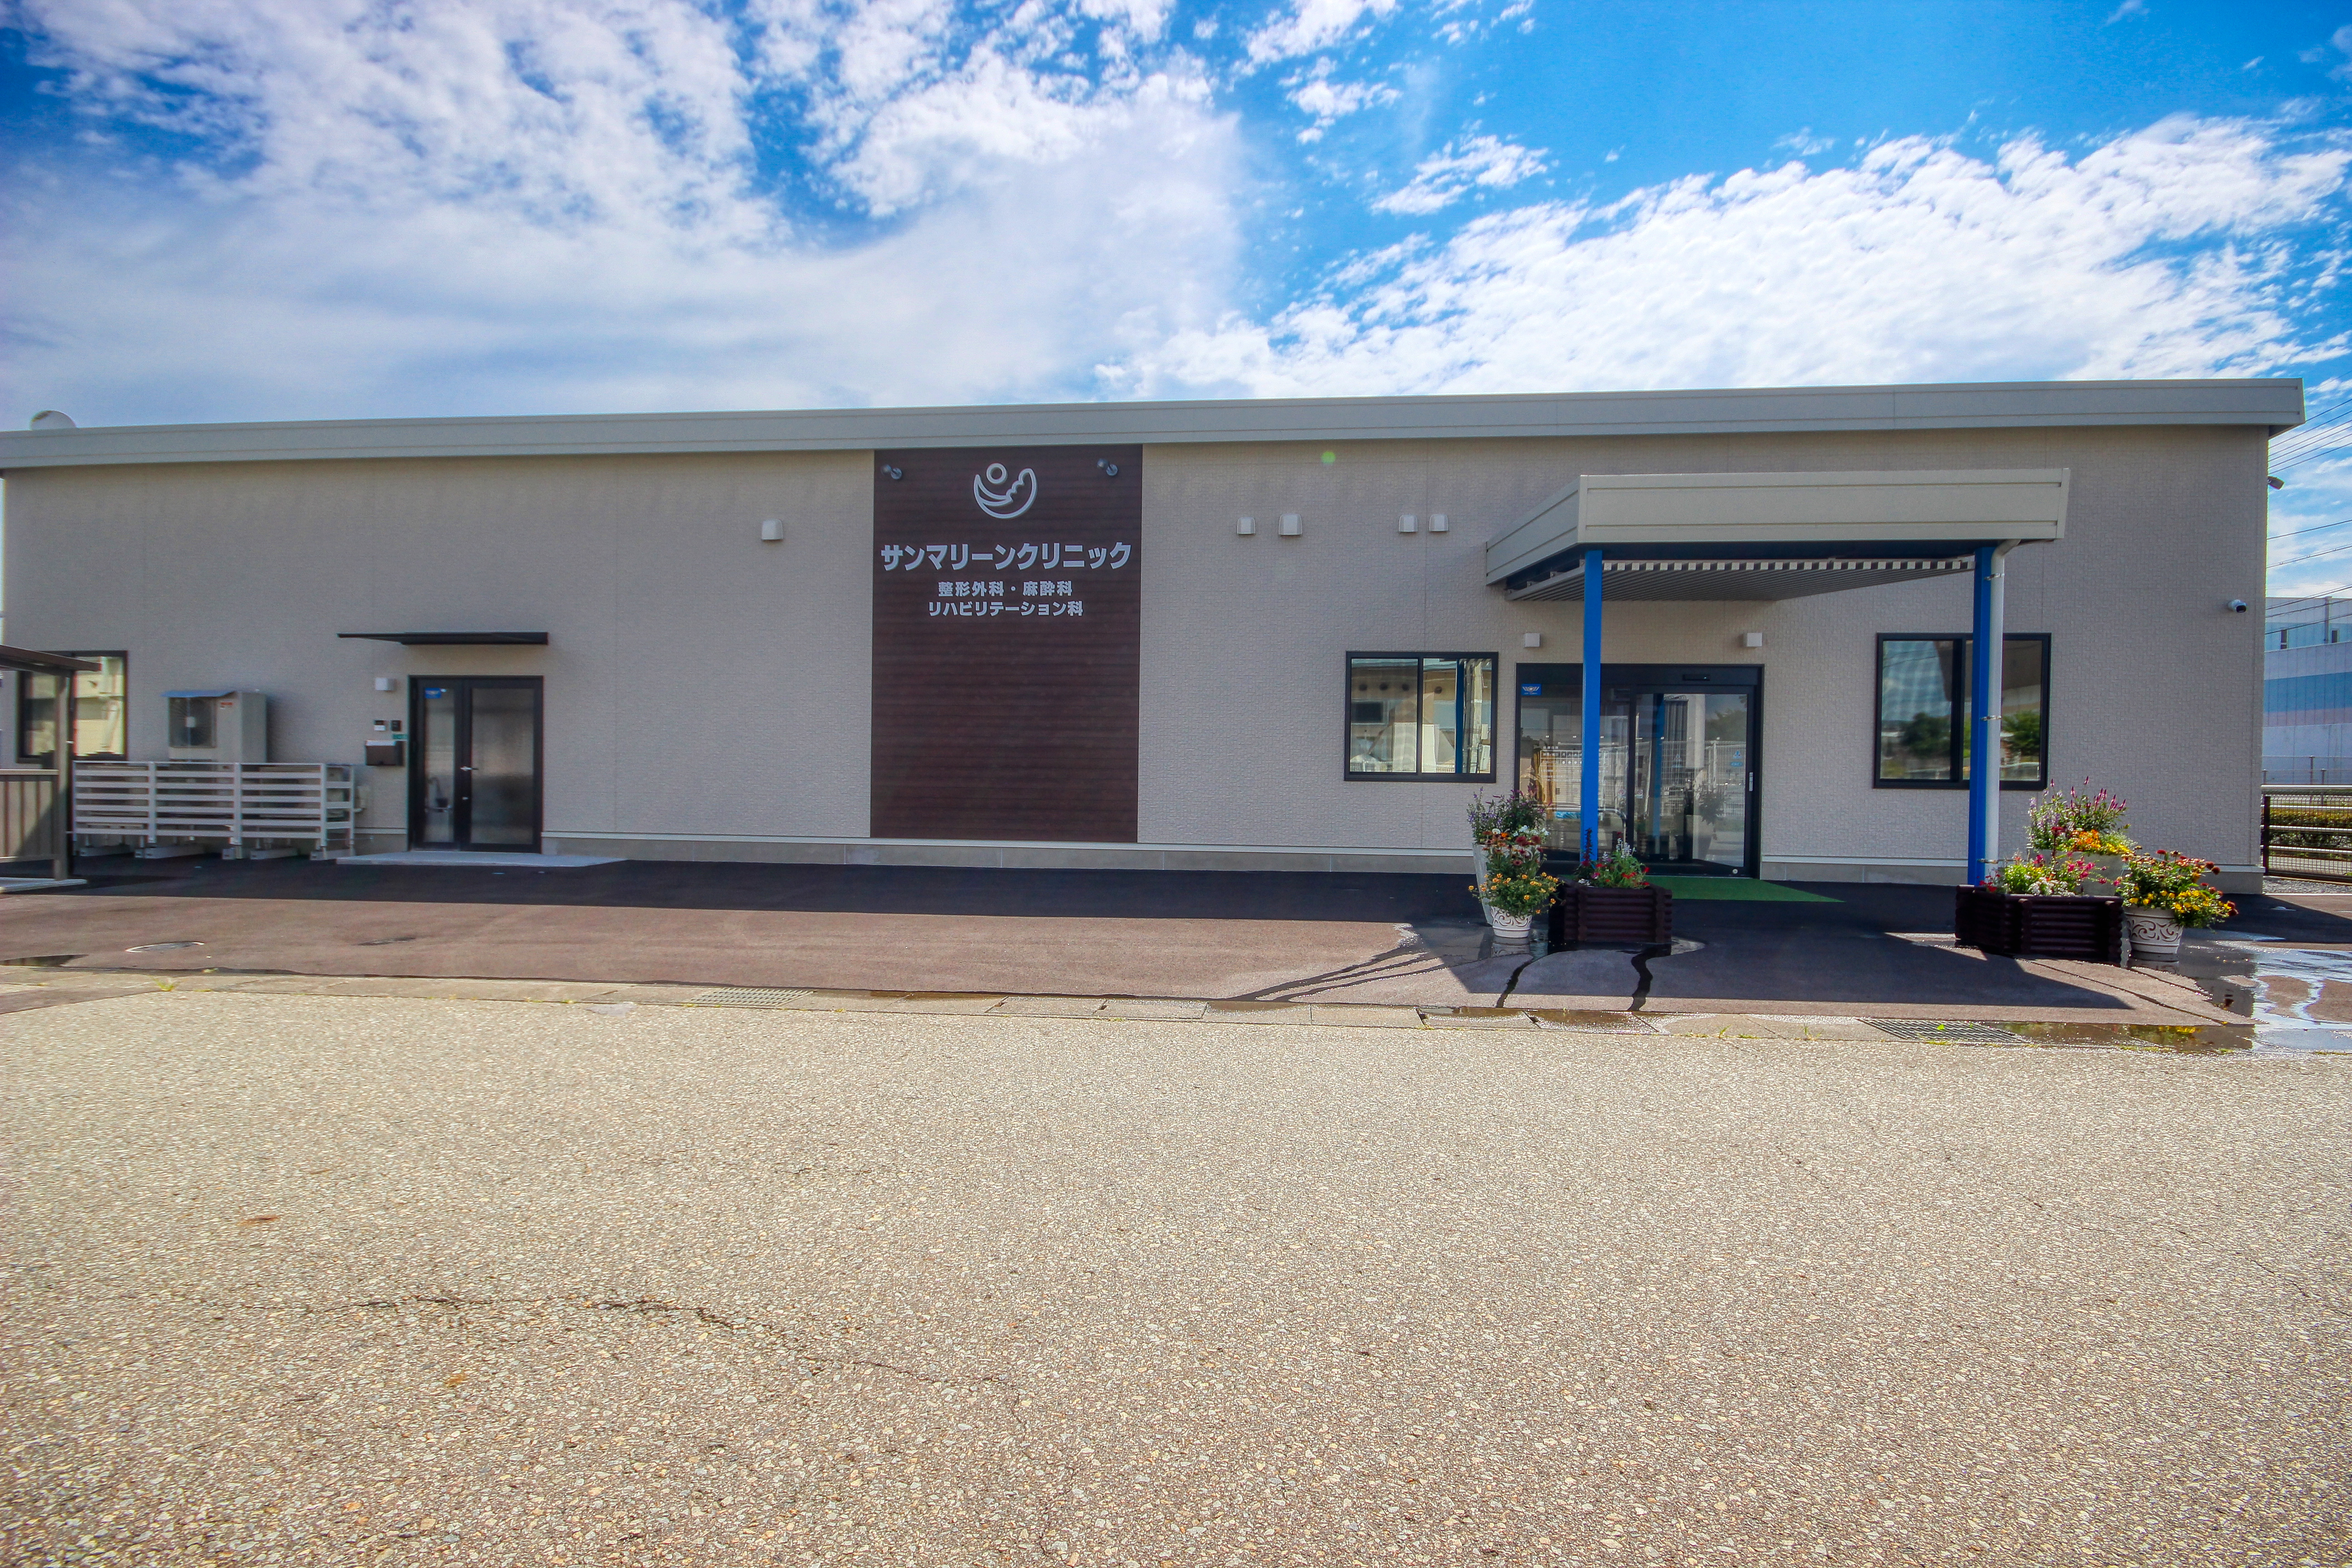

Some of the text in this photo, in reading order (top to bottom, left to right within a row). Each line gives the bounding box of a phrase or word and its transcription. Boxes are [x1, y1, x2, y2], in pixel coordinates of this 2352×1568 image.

[881, 542, 1132, 571] サンマリーンクリニック
[938, 580, 1073, 597] 整形外科・麻酔科
[928, 600, 1083, 617] リハビリテーション科
